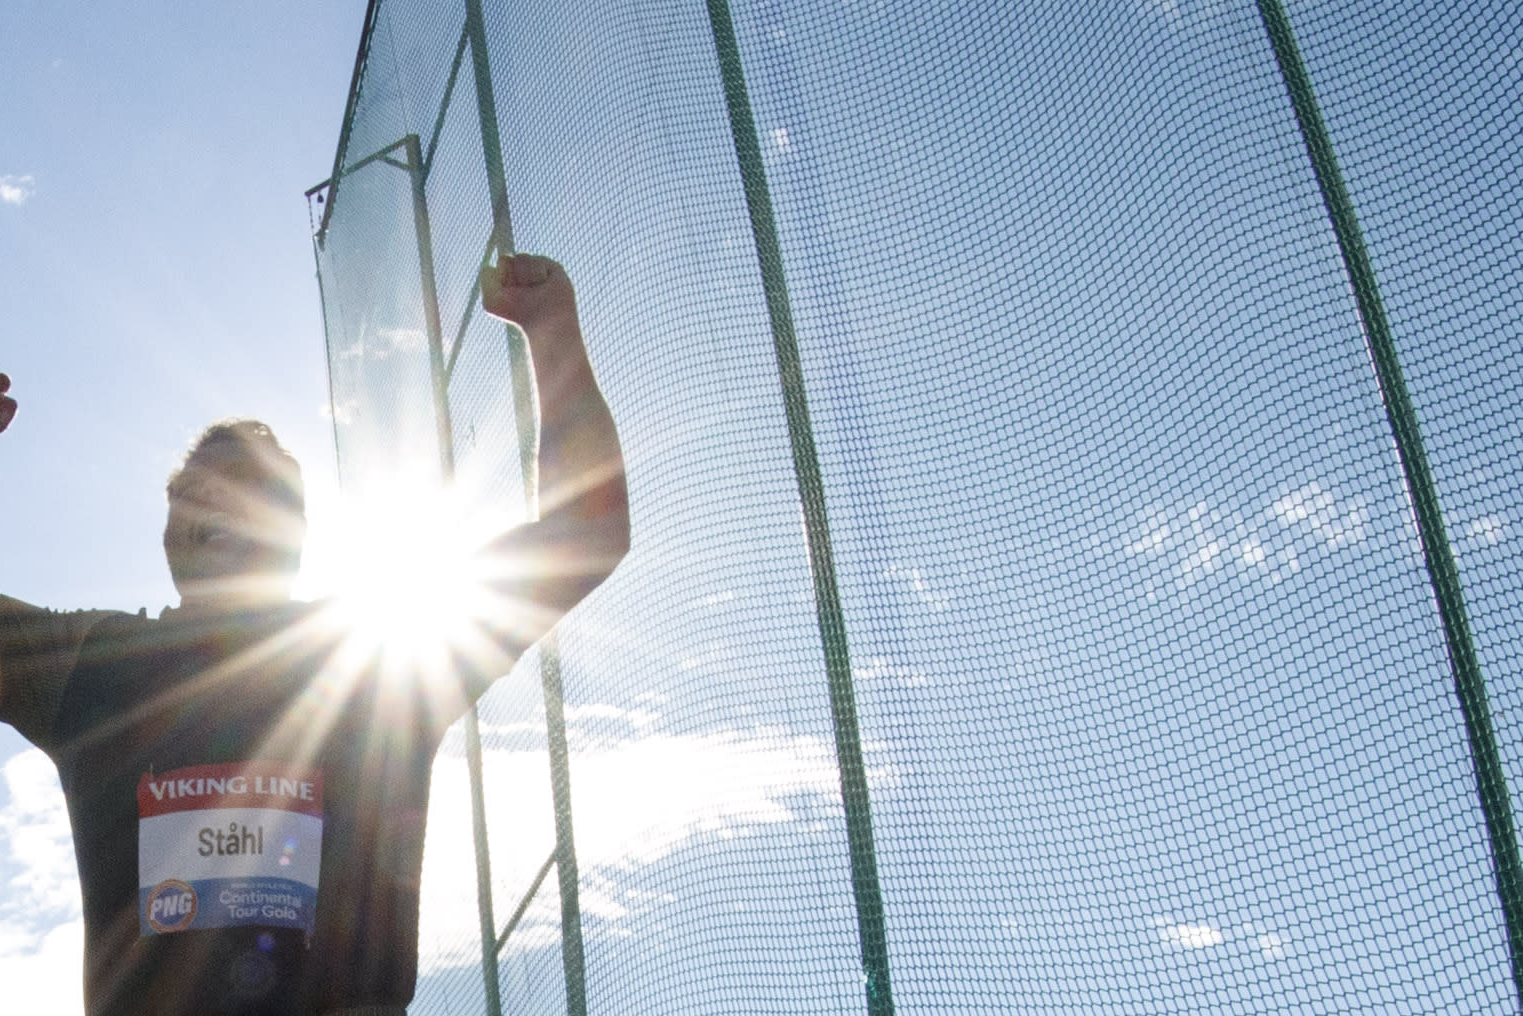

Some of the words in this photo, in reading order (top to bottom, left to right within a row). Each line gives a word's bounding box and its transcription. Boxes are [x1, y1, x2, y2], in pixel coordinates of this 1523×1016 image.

[149, 776, 247, 801] VIKING
[255, 775, 315, 801] LINE
[198, 822, 264, 857] Ståhl
[150, 893, 193, 921] PNG
[228, 904, 259, 919] Tour
